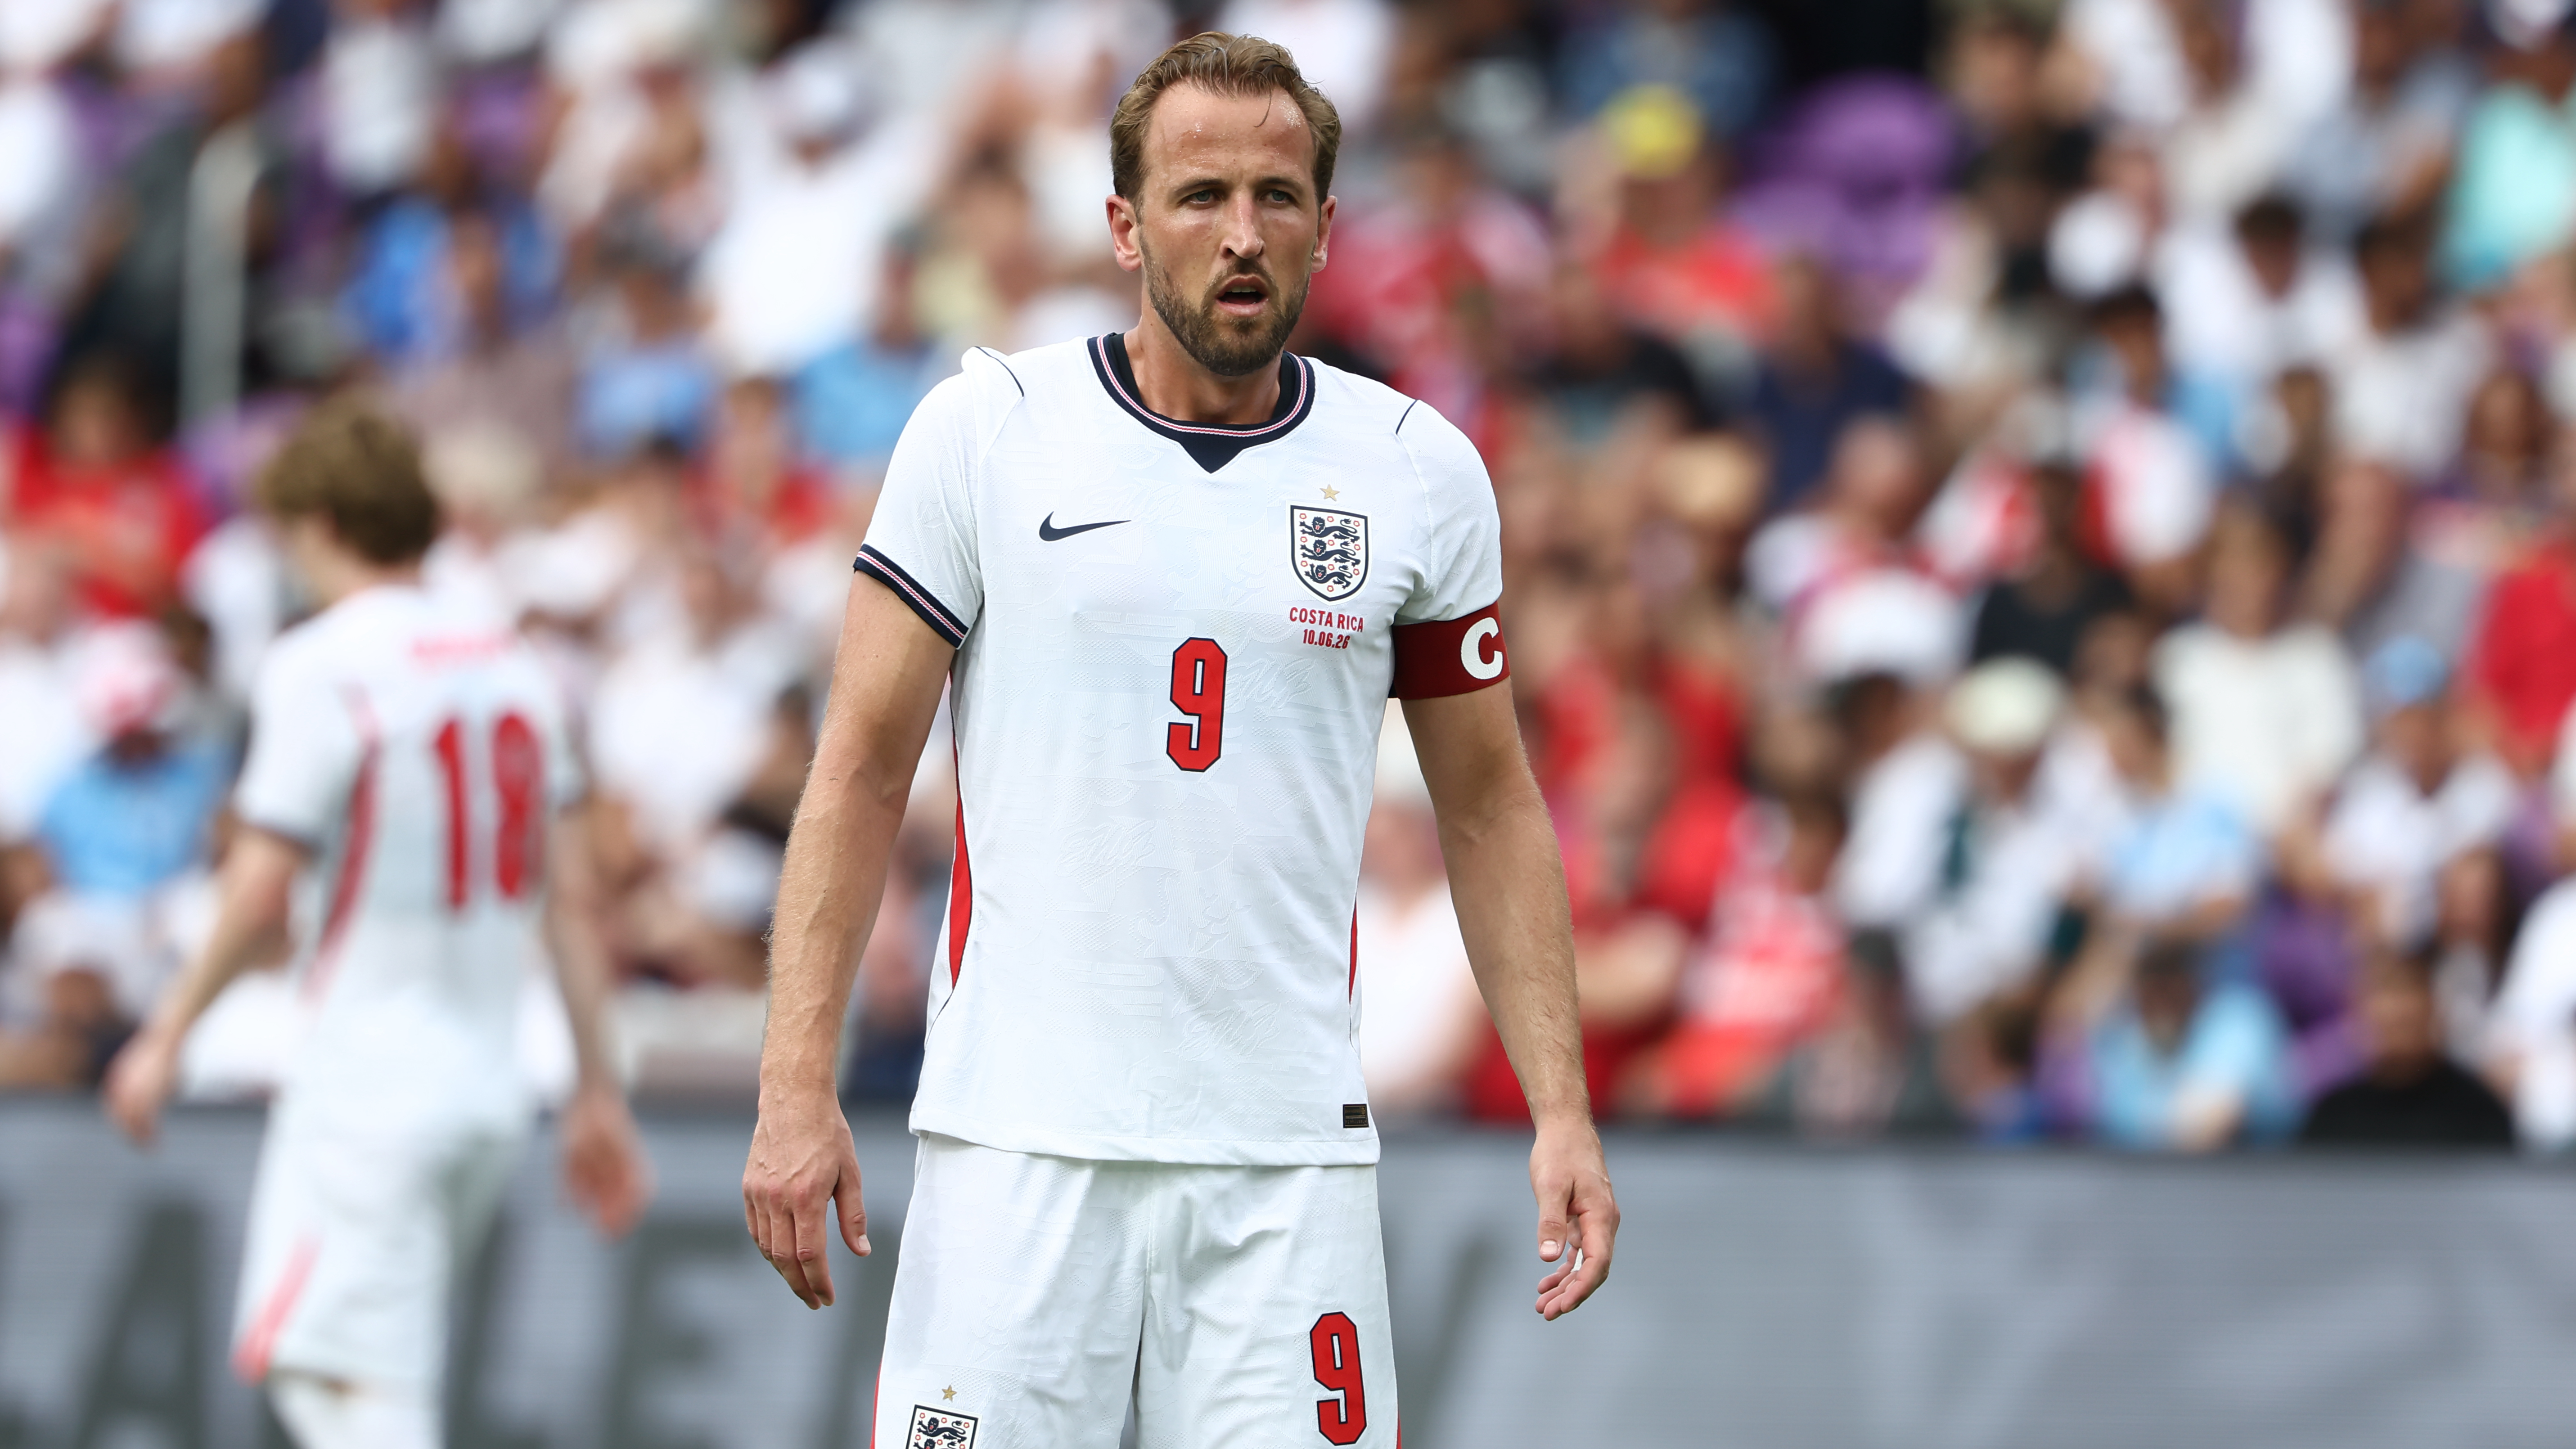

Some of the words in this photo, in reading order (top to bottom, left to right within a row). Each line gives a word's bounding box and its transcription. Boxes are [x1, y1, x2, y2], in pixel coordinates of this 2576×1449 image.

[1289, 607, 1333, 627] COSTA
[1337, 613, 1363, 632] RICA
[1303, 629, 1351, 649] 10.06.26
[1461, 616, 1504, 680] C
[1167, 636, 1227, 772] 9
[1310, 1311, 1366, 1446] 9
